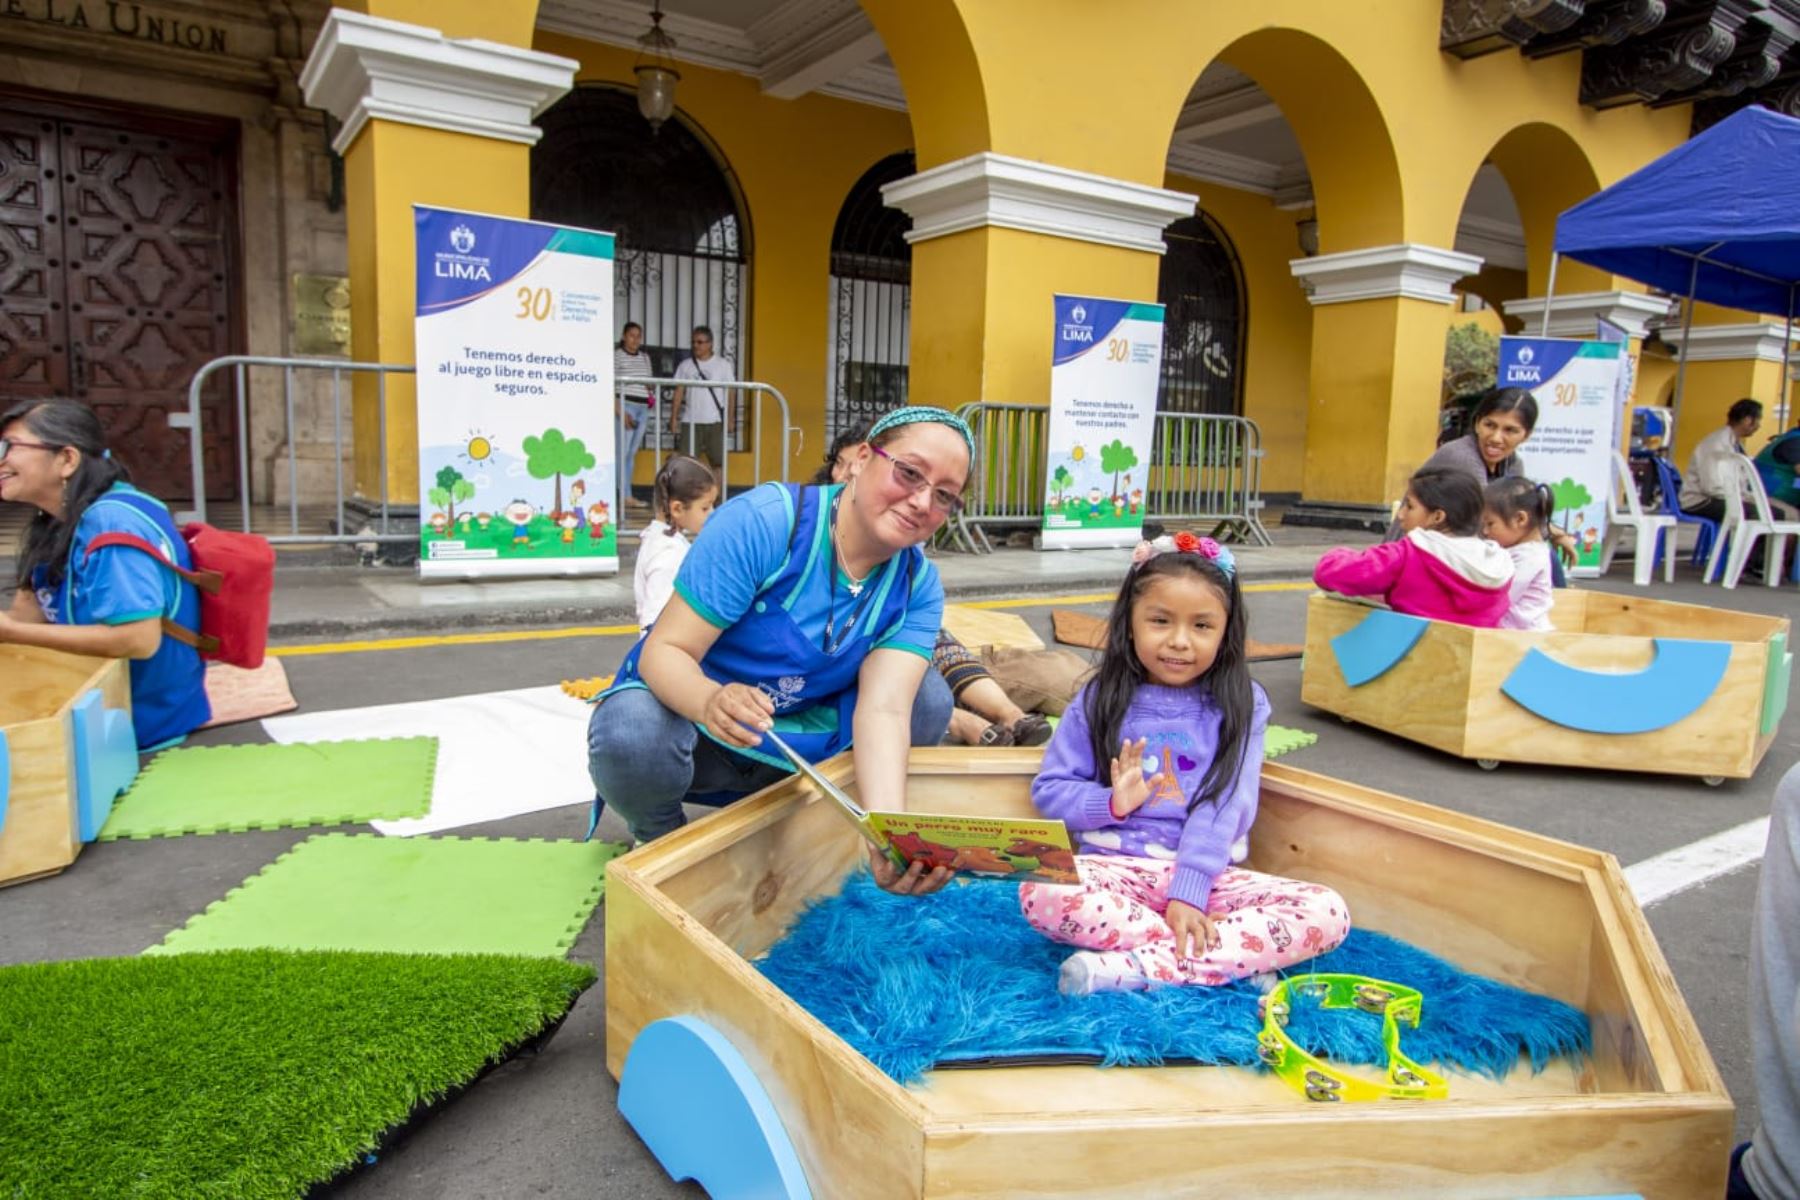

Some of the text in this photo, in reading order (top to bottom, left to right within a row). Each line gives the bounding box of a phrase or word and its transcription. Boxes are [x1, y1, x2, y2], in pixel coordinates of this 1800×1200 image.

[47, 0, 89, 28] LA
[105, 1, 227, 52] UNION
[435, 261, 492, 282] LIMA
[514, 286, 552, 321] 30
[1063, 330, 1093, 342] LIMA
[463, 347, 576, 367] Tenemos derecho
[1107, 337, 1128, 362] 30
[438, 361, 598, 384] al juego libre en espacios
[1507, 369, 1541, 382] LIMA
[494, 381, 548, 396] seguros.
[1553, 383, 1577, 406] 30
[1103, 400, 1129, 410] derecho
[886, 818, 908, 828] Un
[914, 822, 962, 832] perro
[967, 825, 1003, 836] muy
[1009, 828, 1049, 836] raro
